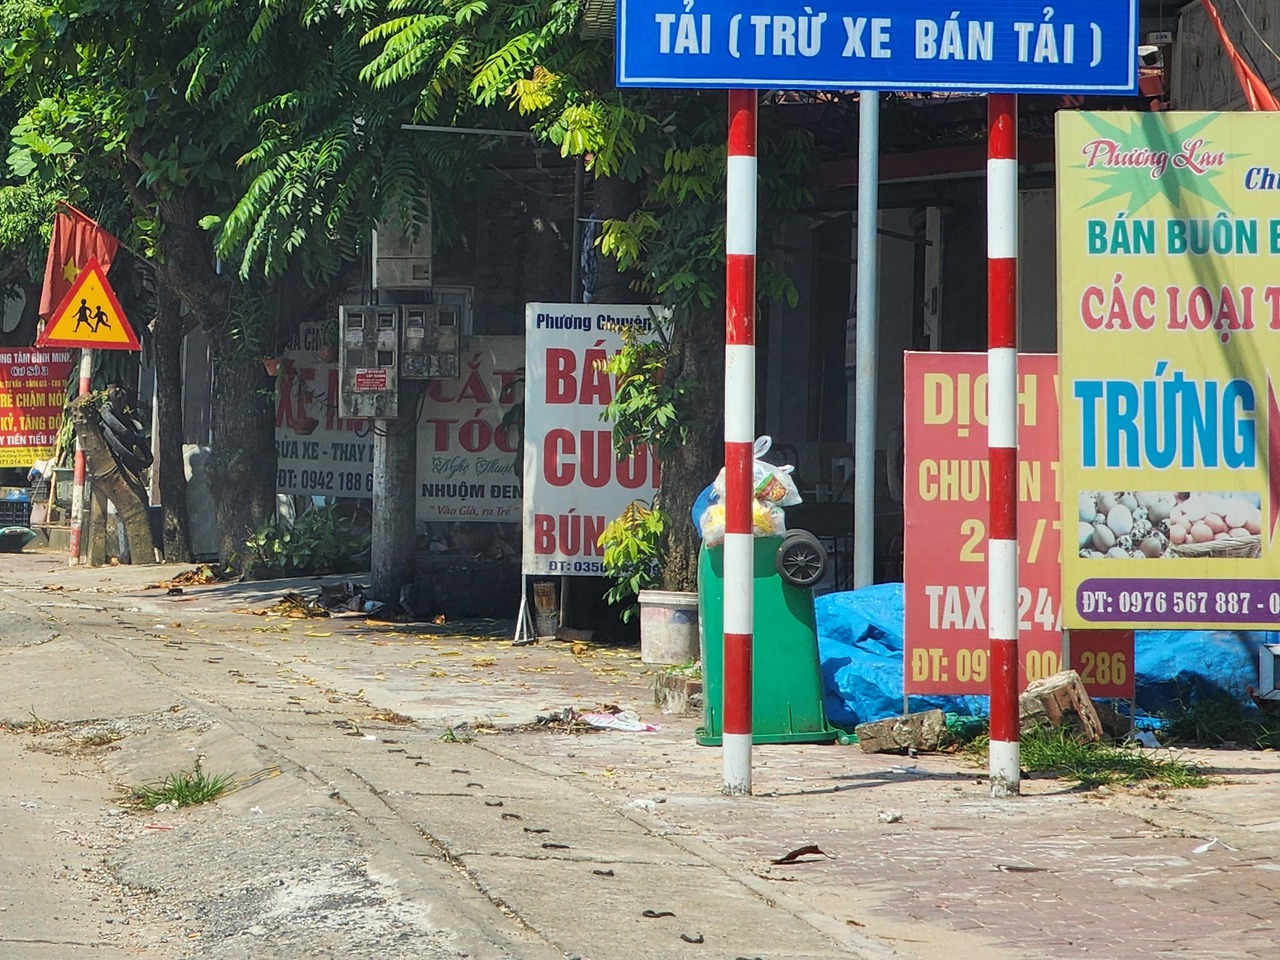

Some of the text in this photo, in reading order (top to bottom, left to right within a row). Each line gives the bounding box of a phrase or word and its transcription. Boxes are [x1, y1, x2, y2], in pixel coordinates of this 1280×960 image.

[842, 17, 892, 59] XE
[915, 11, 994, 62] BÁN
[1082, 139, 1226, 179] Phương Lan
[1087, 212, 1155, 255] BÁN
[1167, 212, 1258, 256] BUÔN
[1081, 273, 1156, 330] CÁC
[1166, 286, 1255, 344] LOẠI
[536, 313, 592, 332] Phương
[13, 351, 30, 364] TÂM
[31, 351, 50, 363] BÌNH
[16, 391, 46, 410] CHẬM
[19, 414, 46, 431] TĂNG
[1073, 360, 1257, 470] TRỨNG
[302, 442, 319, 460] XE
[331, 442, 366, 462] THAY
[301, 470, 334, 490] 0942
[339, 472, 362, 491] 188
[422, 481, 523, 501] NHUỘM ĐEN
[534, 507, 606, 556] BÚN
[548, 560, 571, 571] ĐT:
[925, 586, 986, 630] TAX
[1081, 592, 1113, 613] ĐT:
[1118, 592, 1167, 614] 0976
[1173, 592, 1208, 614] 567
[1215, 592, 1251, 614] 887
[911, 649, 948, 682] ĐT:
[1080, 651, 1126, 685] 286
